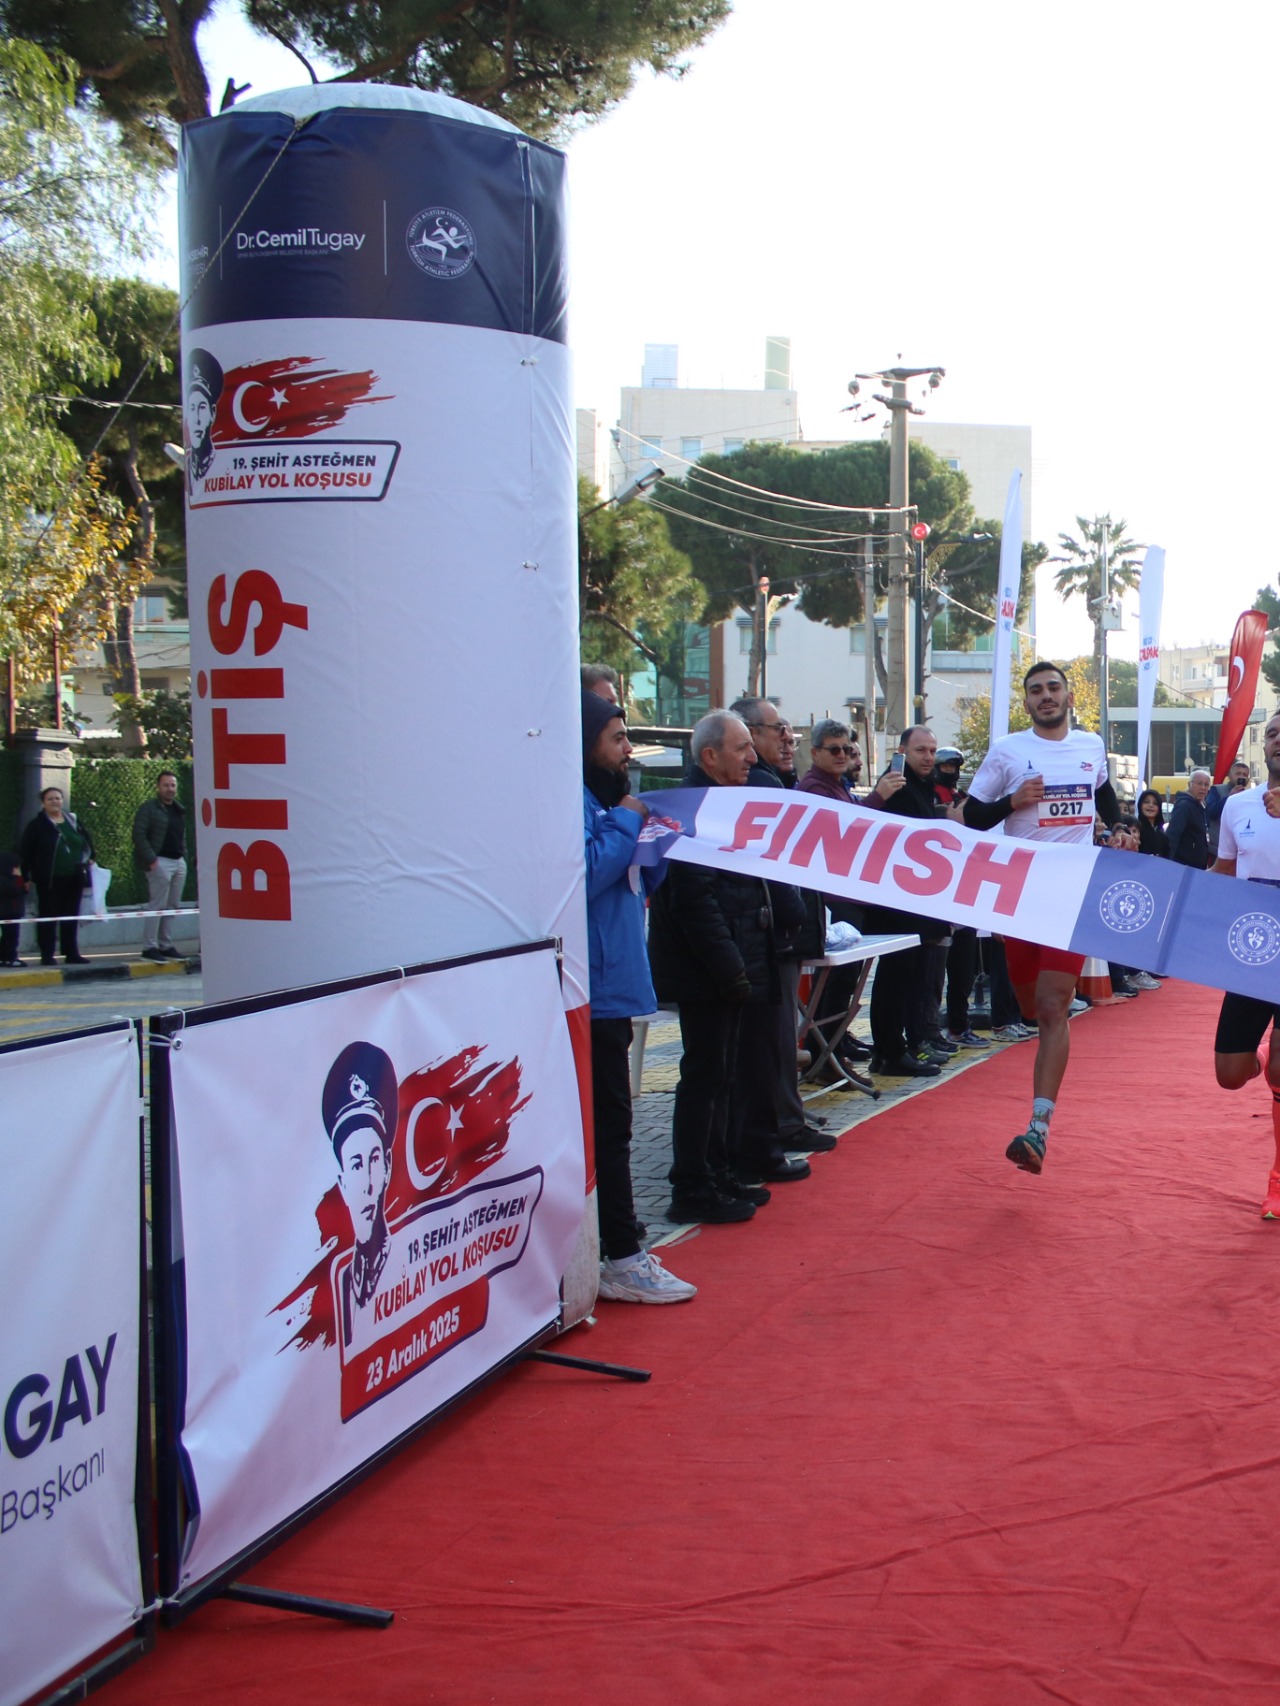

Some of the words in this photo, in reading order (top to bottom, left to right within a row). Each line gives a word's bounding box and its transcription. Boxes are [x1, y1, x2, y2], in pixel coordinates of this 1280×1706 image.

[204, 473, 259, 493] KUBİLAY
[258, 473, 289, 489] YOL
[294, 472, 372, 490] KOŞUSU
[232, 458, 248, 470] 19.
[251, 452, 289, 471] ŞEHİT
[292, 452, 376, 467] ASTEĞMEN
[197, 569, 309, 921] BİTİŞ
[1049, 802, 1083, 816] 0217
[718, 801, 1037, 917] FINISH
[407, 1241, 422, 1264] 19.
[423, 1217, 460, 1260] ŞEHİT
[462, 1194, 529, 1238] ASTEĞMEN
[373, 1265, 428, 1325] KUBİLAY
[429, 1252, 460, 1287] YOL
[462, 1224, 520, 1272] KOŞUSU
[365, 1356, 384, 1393] 23
[386, 1331, 429, 1380] Aralık
[429, 1305, 460, 1347] 2025
[0, 1447, 105, 1534] Başkanı
